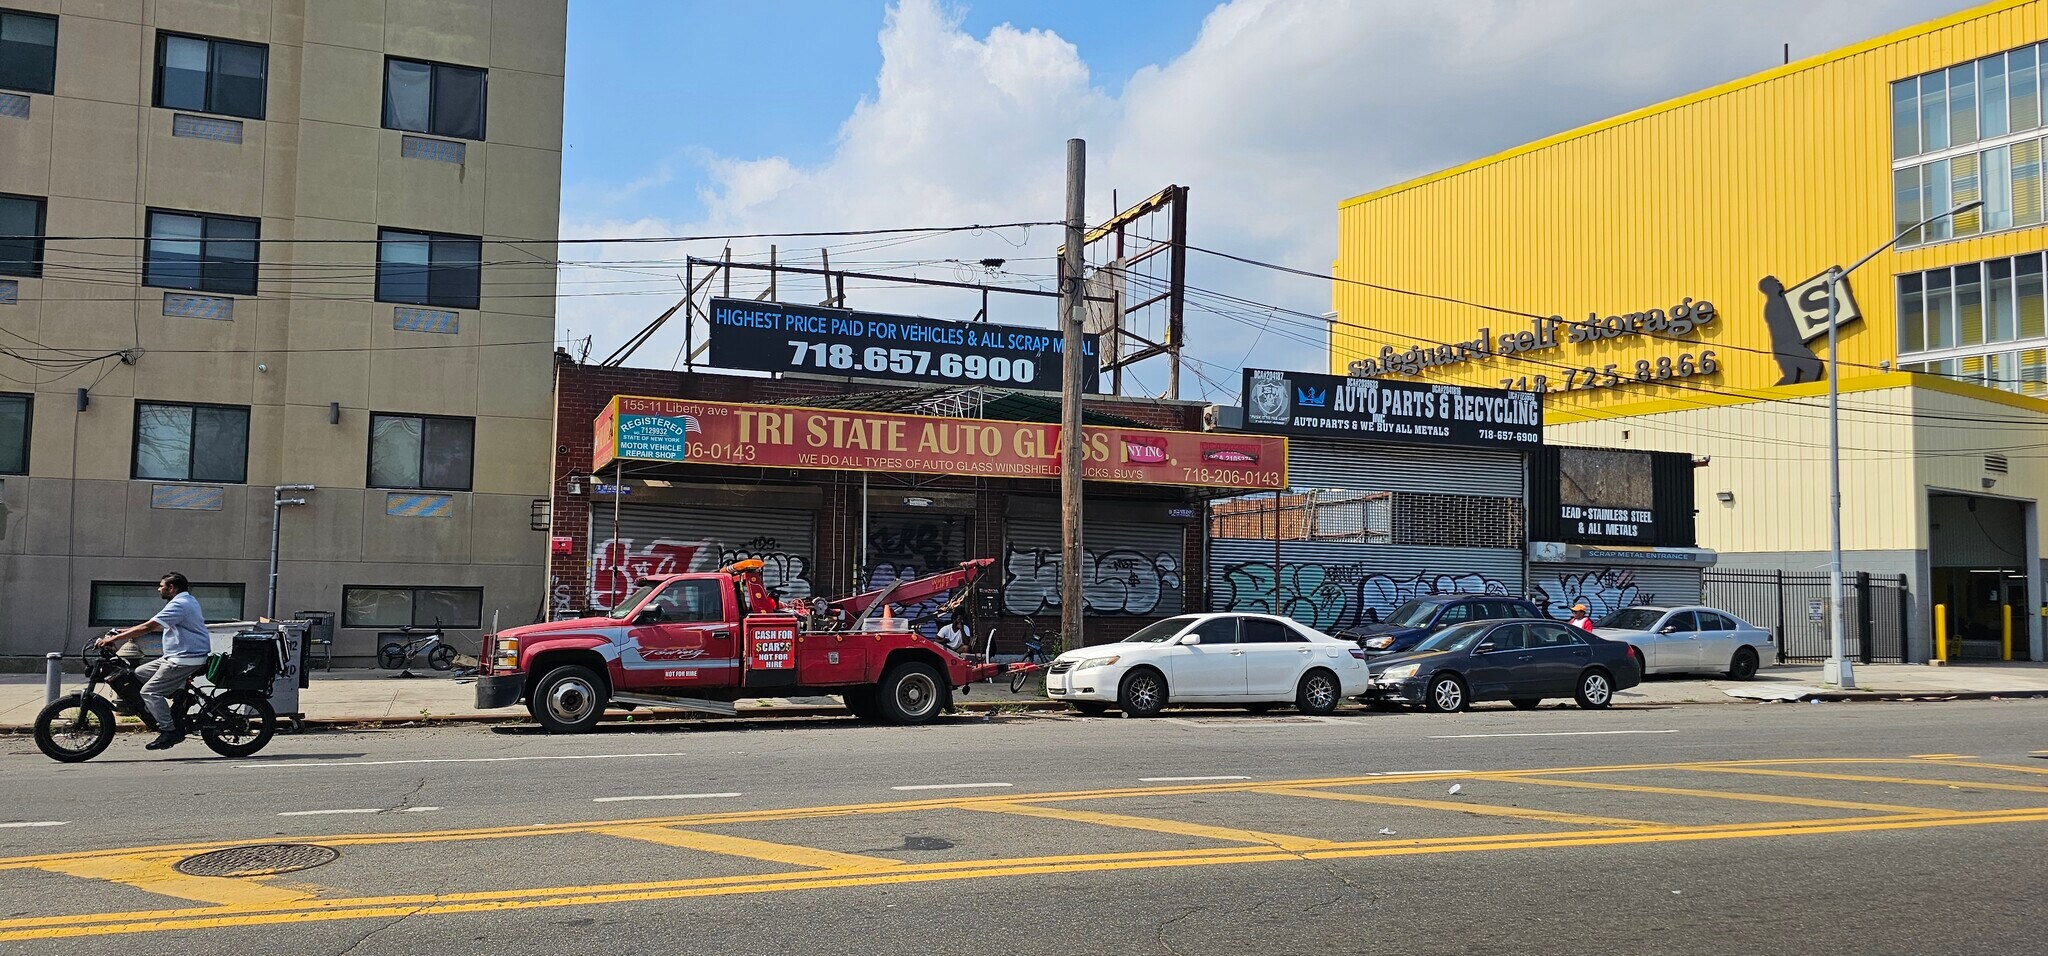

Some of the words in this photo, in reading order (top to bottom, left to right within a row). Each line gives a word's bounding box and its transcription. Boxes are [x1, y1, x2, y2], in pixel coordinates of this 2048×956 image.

[1798, 280, 1840, 330] S
[716, 308, 782, 330] HIGHEST
[785, 314, 827, 334] PRICE
[831, 318, 864, 337] PAID
[867, 321, 897, 340] FOR
[900, 323, 964, 346] VEHICLES
[967, 330, 978, 347] &
[981, 331, 1005, 349] ALL
[1008, 333, 1050, 352] SCRAP
[1053, 337, 1094, 356] MAL
[1347, 327, 1492, 377] safeguard
[1497, 315, 1563, 355] self
[1568, 297, 1715, 343] storage
[787, 340, 1035, 383] 718.657.6900
[1499, 350, 1717, 394] 718.725.8866
[623, 400, 662, 413] 155-11
[665, 402, 704, 417] Liberty
[707, 406, 728, 416] ave
[1333, 385, 1378, 414] AUTO
[1381, 388, 1435, 418] PARTS
[1439, 394, 1450, 420] &
[1453, 395, 1538, 426] RECYCLING
[620, 417, 683, 435] REGISTERED
[734, 410, 794, 446] TRI
[806, 414, 908, 452] STATE
[918, 422, 1002, 457] AUTO
[1294, 417, 1318, 427] AUTO
[1320, 418, 1350, 430] PARTS
[1352, 420, 1358, 430] &
[1360, 421, 1374, 431] WE
[1376, 422, 1394, 433] BUY
[1395, 423, 1413, 434] ALL
[1414, 425, 1450, 437] METALS
[1479, 429, 1538, 443] 718-657-6900
[620, 441, 649, 450] MOTOR
[649, 443, 682, 452] VEHICLE
[626, 450, 654, 458] REPAIR
[655, 451, 677, 459] SHOP
[1127, 445, 1142, 457] NY
[1145, 446, 1164, 458] INC
[799, 453, 818, 464] WE
[821, 454, 839, 465] DO
[841, 456, 862, 467] ALL
[864, 457, 902, 469] TYPES
[905, 458, 921, 469] OF
[923, 459, 953, 471] AUTO
[956, 461, 993, 472] GLASS
[1114, 469, 1143, 480] SUV'S
[1183, 467, 1280, 486] 718-206-0143
[1562, 506, 1581, 519] LEAD
[1588, 508, 1628, 521] STAINLESS
[1631, 510, 1652, 523] STEEL
[1578, 522, 1585, 534] &
[1588, 523, 1602, 535] ALL
[1605, 524, 1638, 536] METALS
[1618, 551, 1644, 559] METAL
[755, 630, 777, 640] CASH
[777, 630, 793, 640] FOR
[758, 653, 774, 661] NOT
[774, 653, 788, 661] FOR
